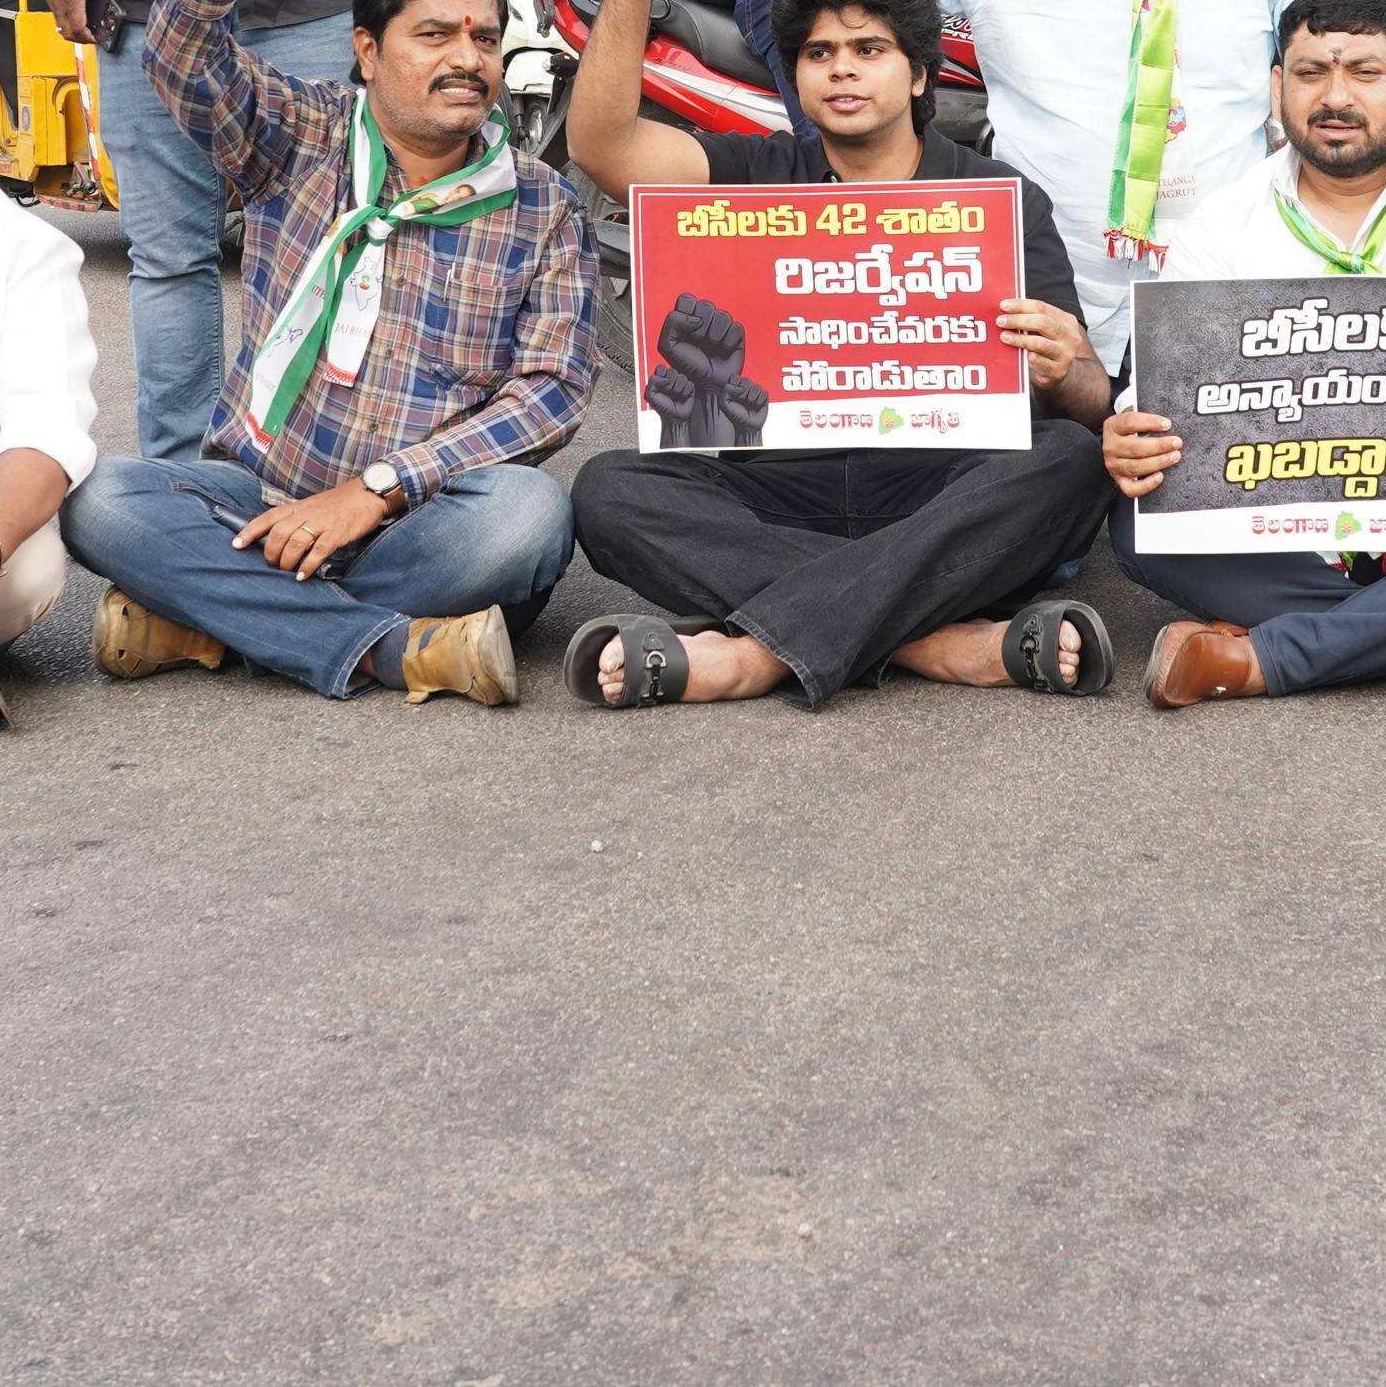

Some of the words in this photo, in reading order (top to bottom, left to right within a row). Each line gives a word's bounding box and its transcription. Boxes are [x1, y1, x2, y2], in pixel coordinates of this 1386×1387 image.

[676, 200, 808, 239] బీసీలకు
[815, 202, 867, 237] 42
[875, 200, 986, 234] శాతం
[774, 243, 984, 306] రిజర్వేషన్
[779, 311, 988, 349] సాధించేవరకు
[781, 359, 988, 392] పోరాడుతాం
[799, 409, 874, 429] తెలంగాణ
[910, 409, 960, 436] జాగృతి
[1251, 515, 1329, 535] తెలంగాణ
